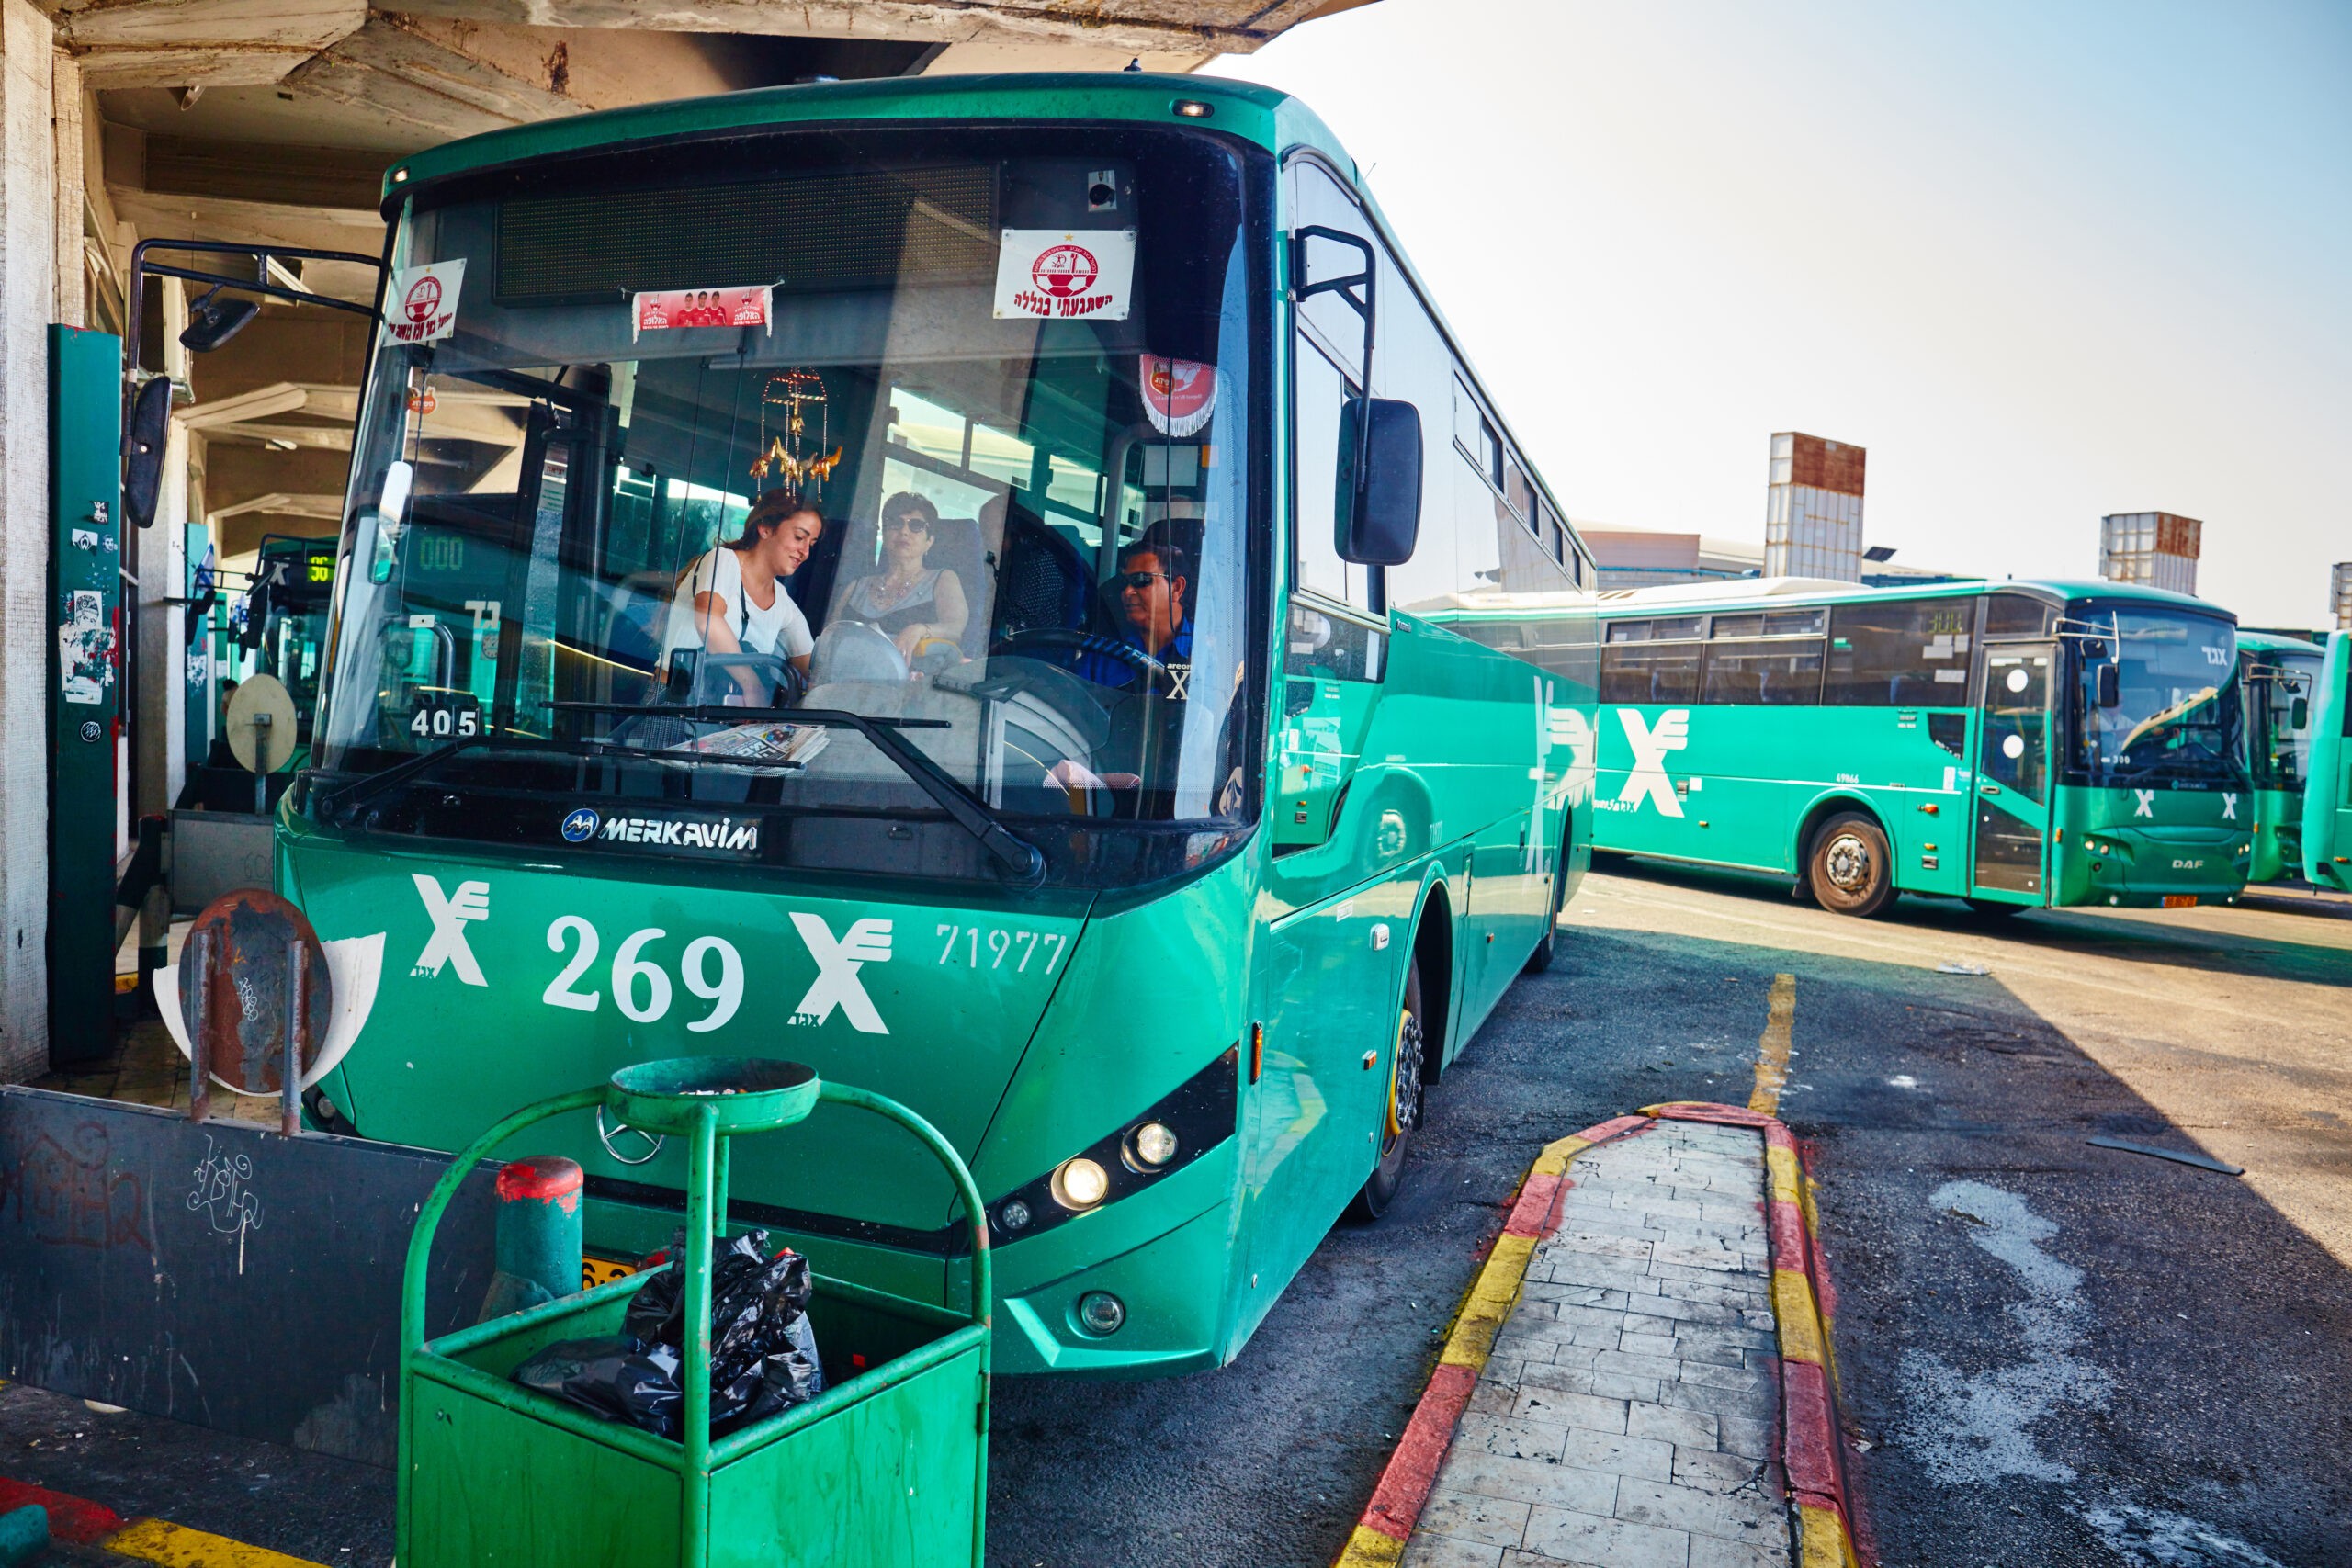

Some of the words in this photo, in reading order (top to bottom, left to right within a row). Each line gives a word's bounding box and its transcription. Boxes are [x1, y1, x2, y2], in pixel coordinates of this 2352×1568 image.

[1013, 290, 1051, 316] בגללה
[1057, 294, 1113, 317] השתגעתי
[2201, 645, 2228, 666] אגד
[1166, 671, 1191, 700] X
[411, 710, 478, 738] 405
[2172, 859, 2204, 869] DAF
[935, 923, 1067, 976] 71977
[542, 915, 745, 1033] 269
[793, 1012, 820, 1027] אגד
